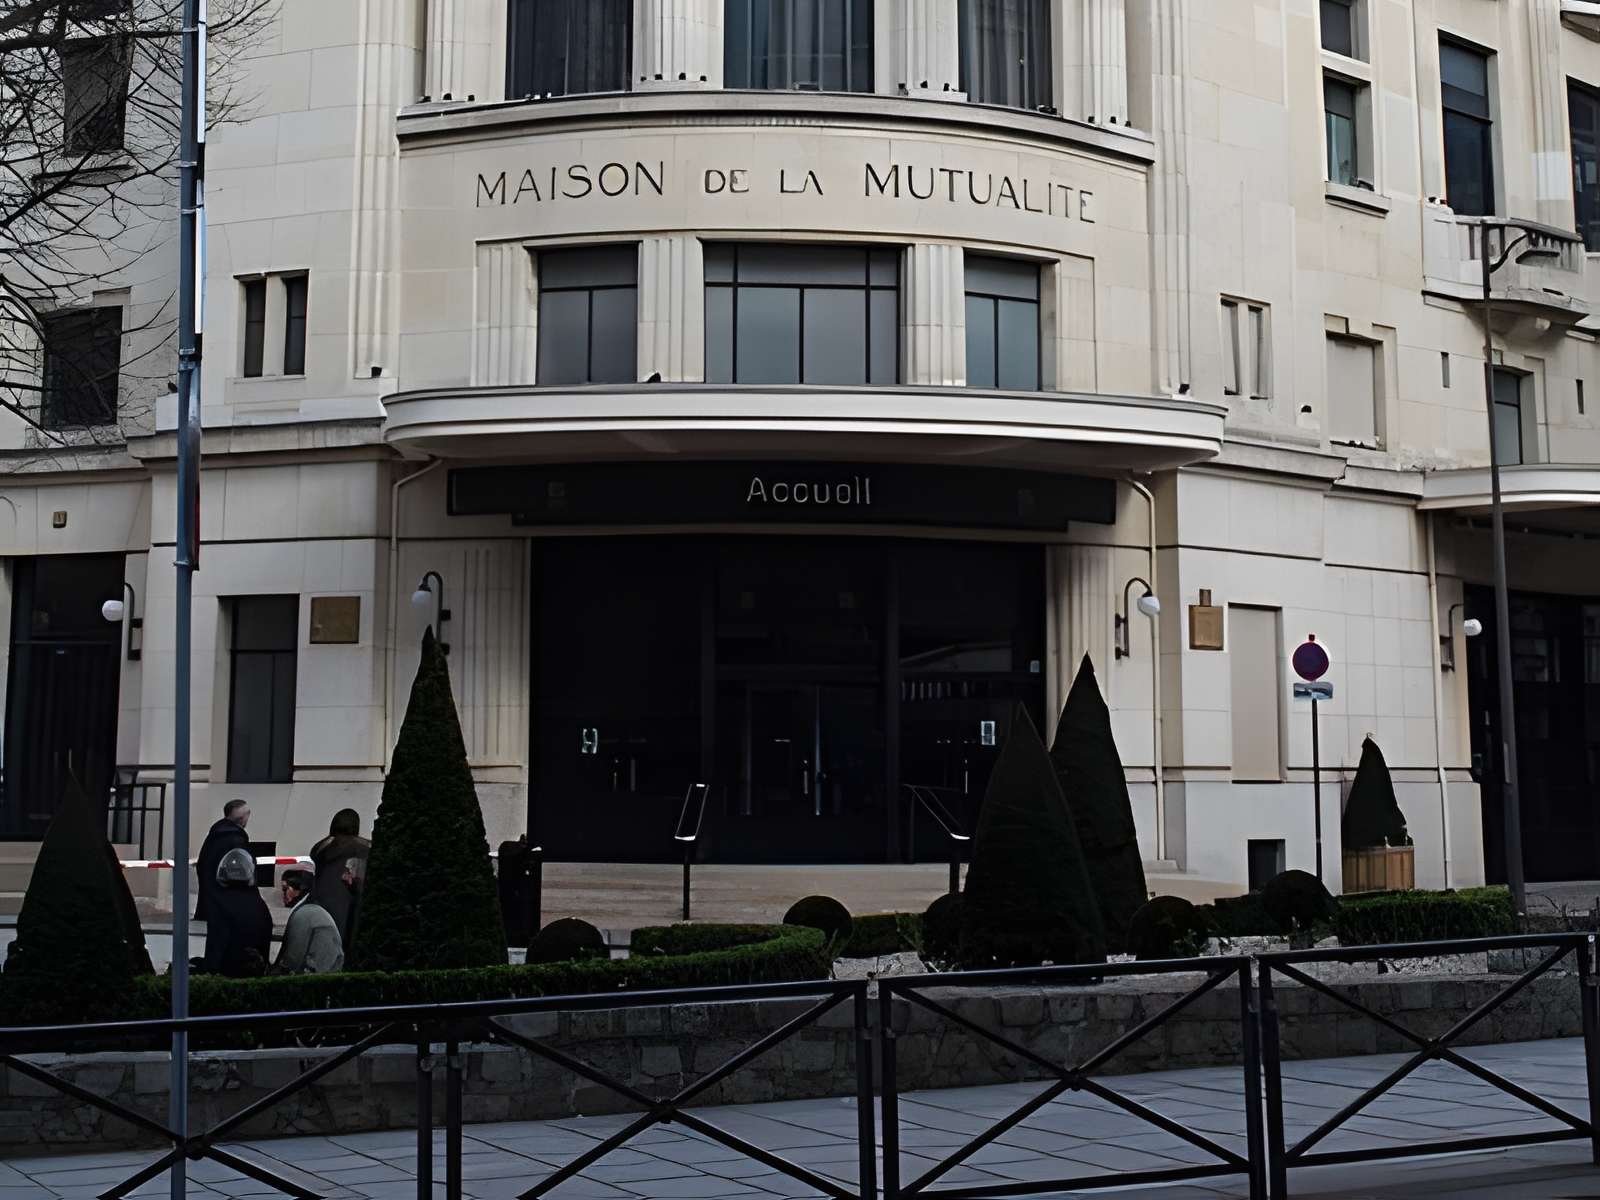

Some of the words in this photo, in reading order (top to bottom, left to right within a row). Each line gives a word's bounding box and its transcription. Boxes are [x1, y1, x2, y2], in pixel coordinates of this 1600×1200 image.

[476, 161, 664, 208] MAISON
[704, 169, 750, 194] DE
[780, 168, 824, 196] LA
[865, 162, 1096, 224] MUTUALITE
